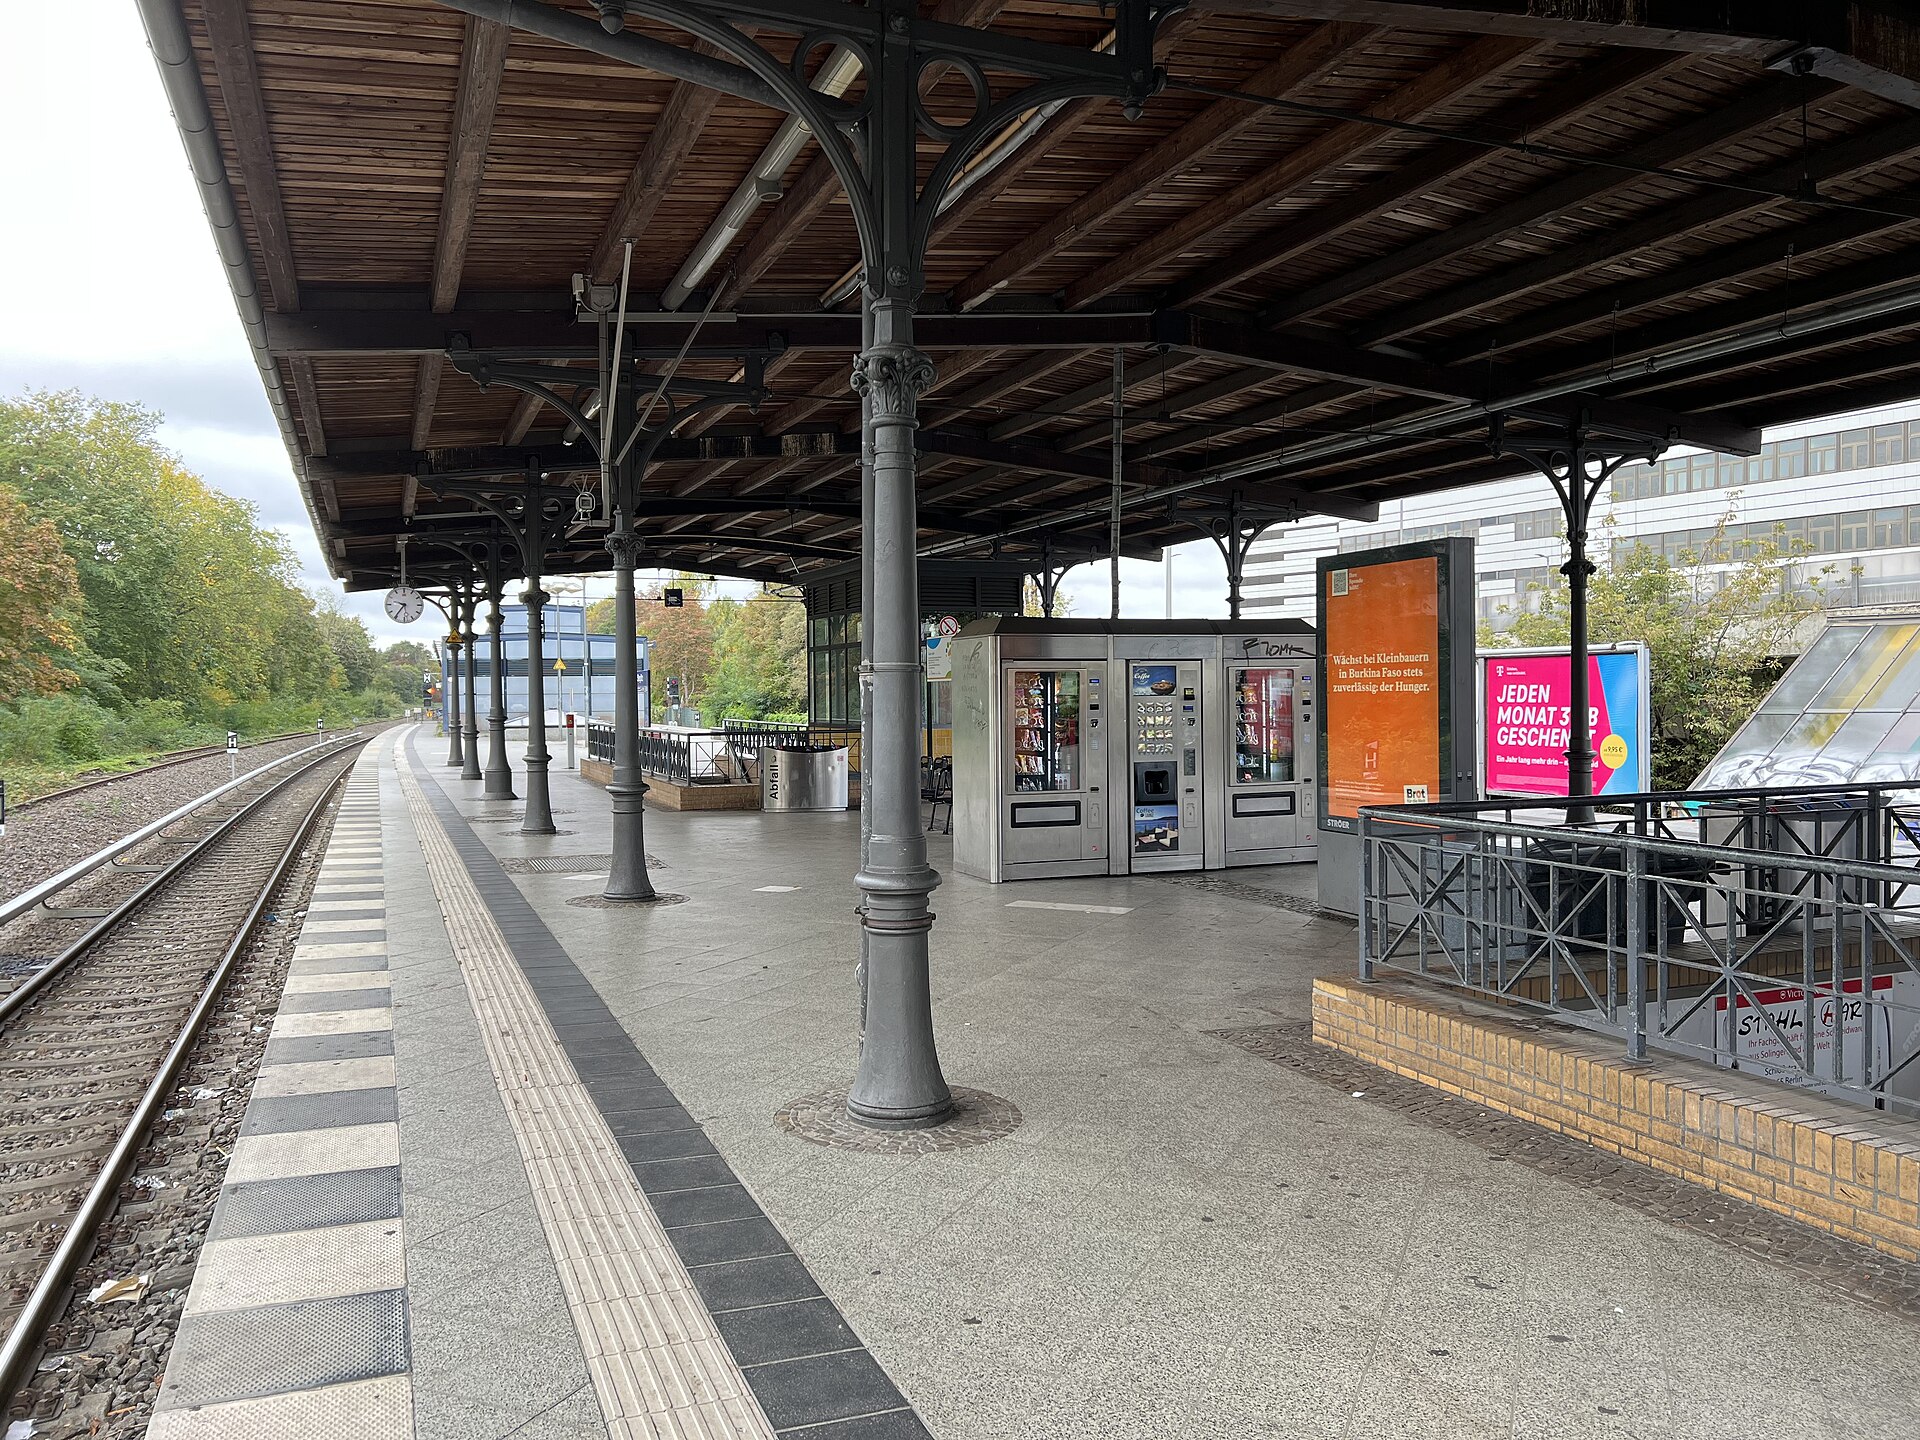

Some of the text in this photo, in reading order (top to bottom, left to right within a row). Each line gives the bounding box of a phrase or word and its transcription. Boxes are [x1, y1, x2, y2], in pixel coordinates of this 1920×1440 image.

[1333, 653, 1429, 665] Wächst bei Kleinbauern
[1339, 668, 1423, 679] in Burkina Faso stets
[1333, 681, 1430, 694] zuverlässig: der Hunger.
[1497, 684, 1550, 703] JEDEN
[1497, 706, 1557, 725] MONAT
[228, 738, 237, 747] H
[1497, 726, 1596, 748] GESCHENT
[1505, 755, 1517, 763] Jahr
[1518, 756, 1530, 765] lang
[769, 765, 779, 800] Abfall
[1406, 788, 1425, 799] Brot
[1327, 819, 1350, 829] STRÖER
[1748, 1040, 1758, 1049] Ihr
[1816, 1042, 1830, 1050] Welt
